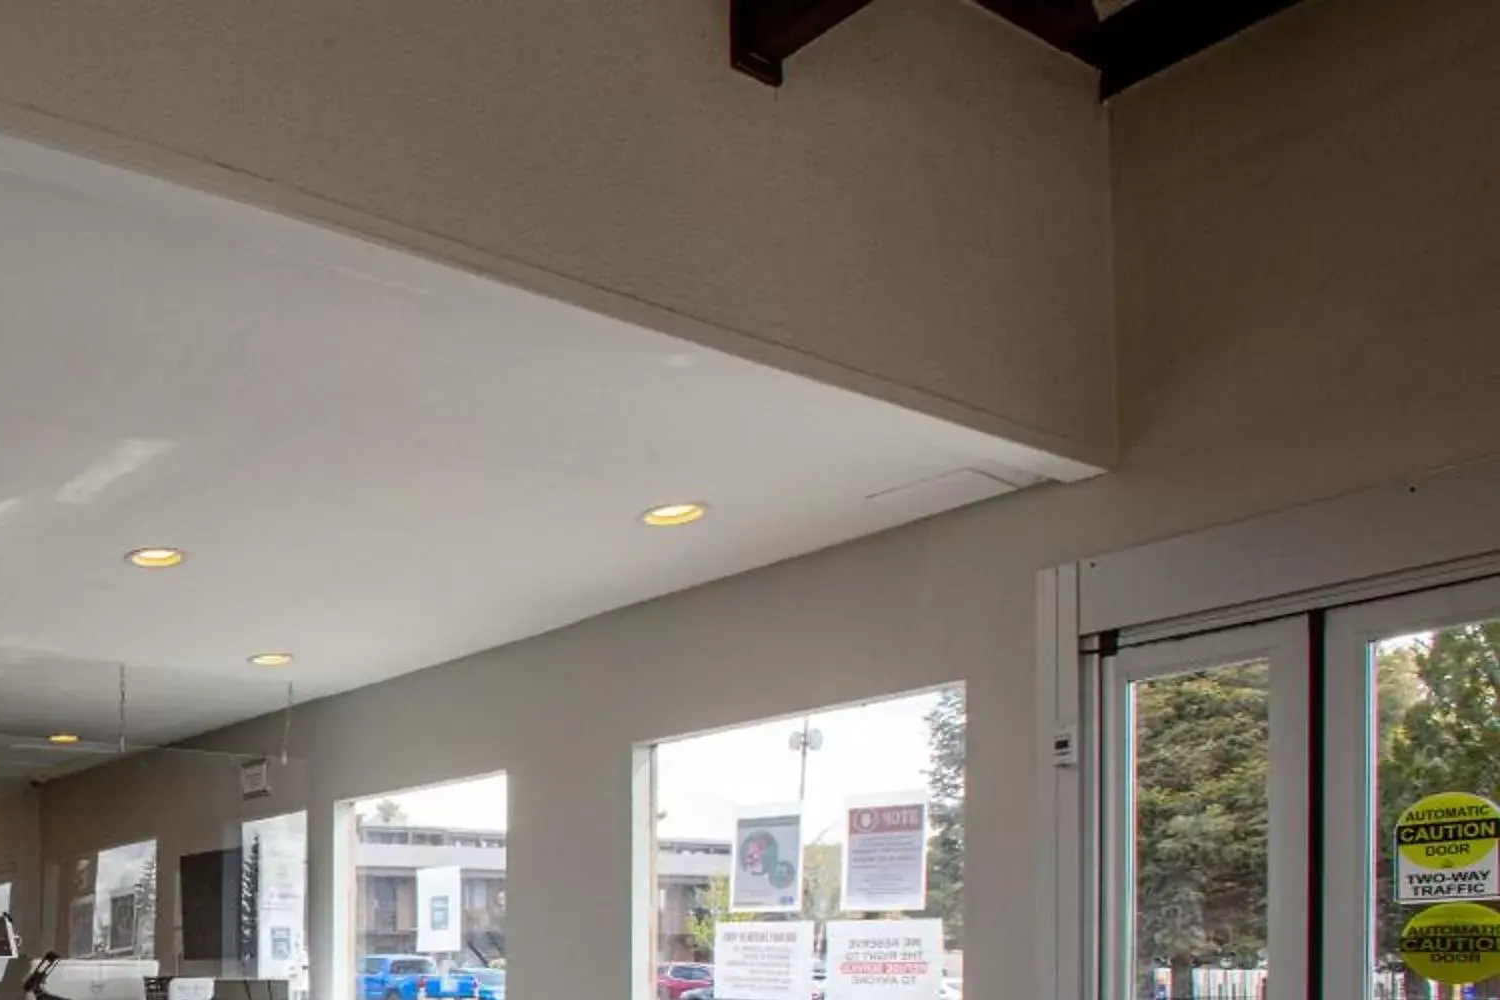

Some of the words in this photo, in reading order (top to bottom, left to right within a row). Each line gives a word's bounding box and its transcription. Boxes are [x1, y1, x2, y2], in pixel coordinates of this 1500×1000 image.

[1405, 804, 1489, 821] AUTOMATIC
[1400, 819, 1495, 842] CAUTION
[1425, 843, 1470, 857] DOOR
[1407, 869, 1490, 884] TWO-WAY
[1412, 882, 1485, 896] TRAFFIC
[1402, 938, 1500, 952] CAUTIO
